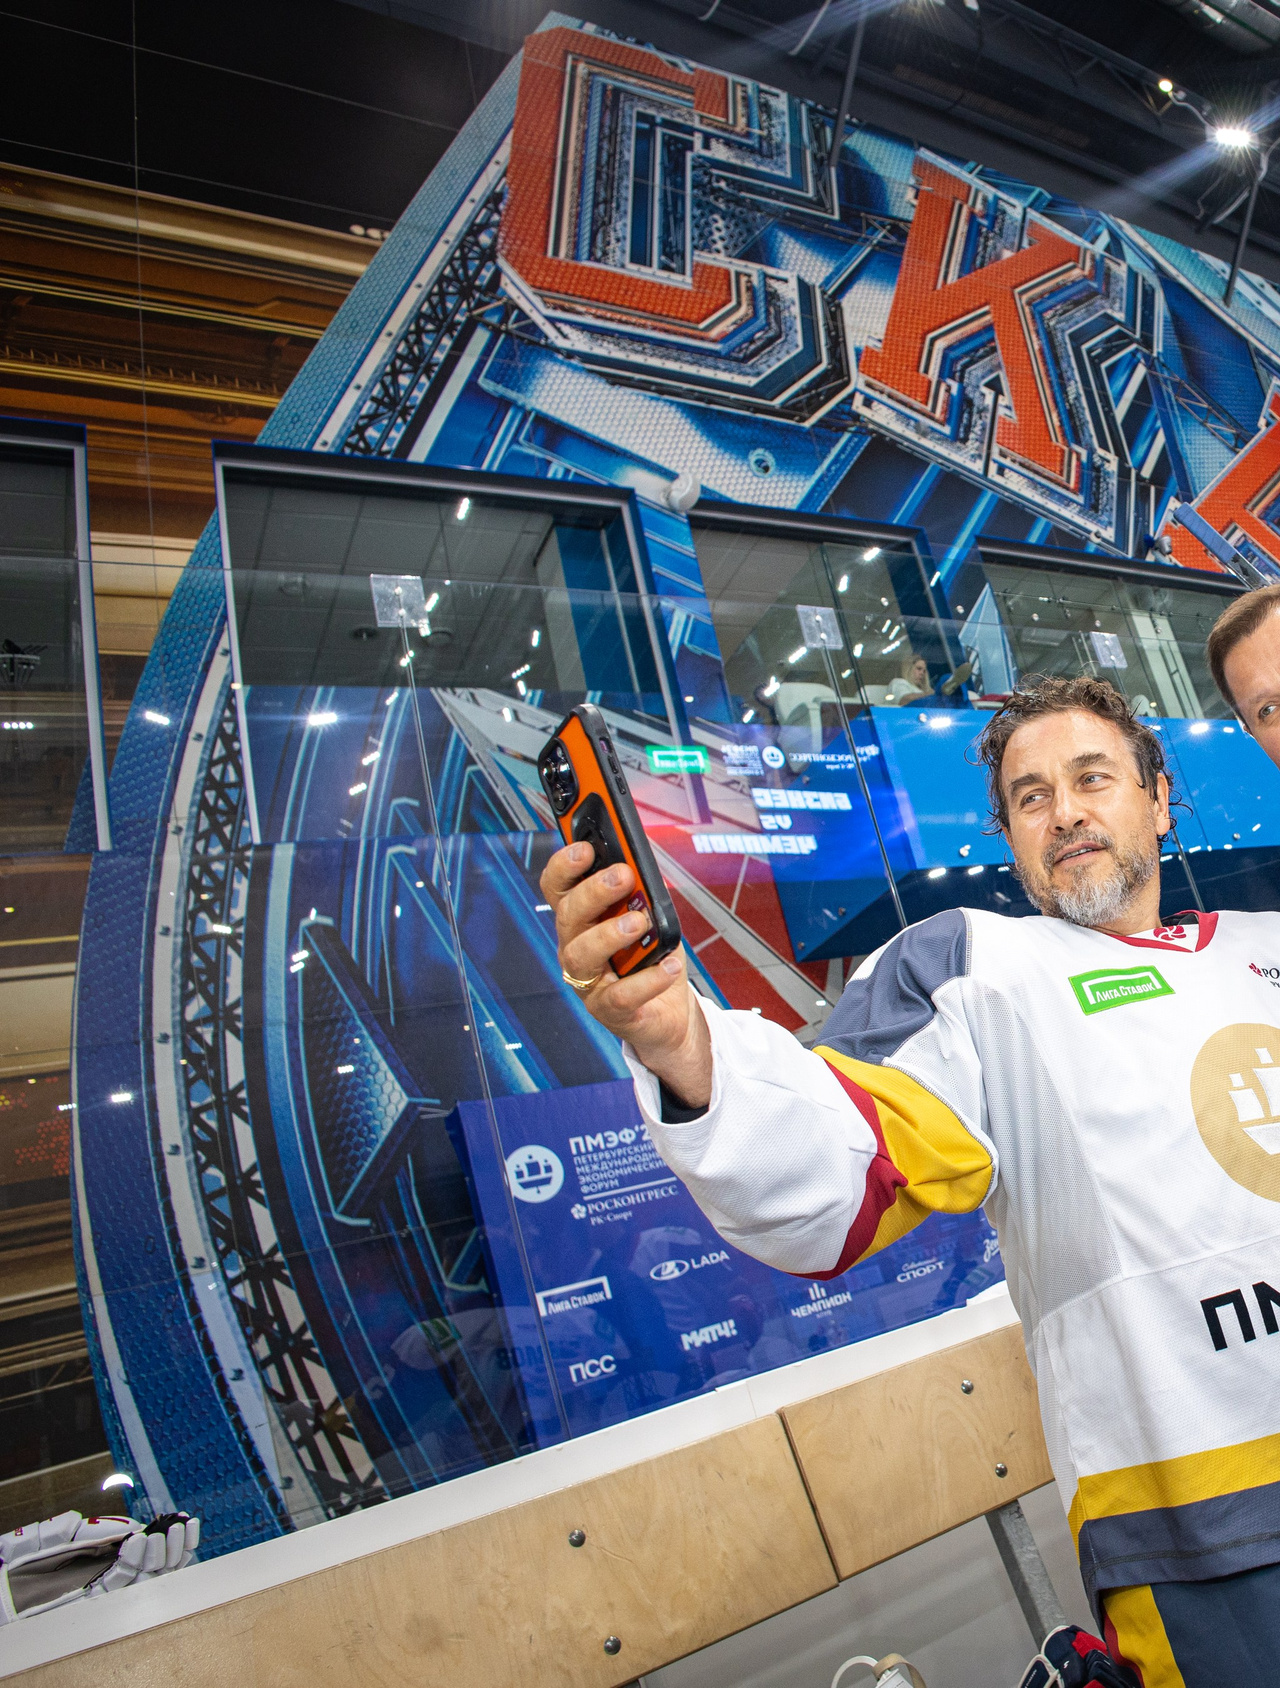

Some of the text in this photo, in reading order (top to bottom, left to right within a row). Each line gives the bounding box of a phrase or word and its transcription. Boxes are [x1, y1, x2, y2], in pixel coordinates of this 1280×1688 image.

[580, 1178, 620, 1194] ФОРУМ
[587, 1184, 679, 1215] РОСКОНГРЕСС
[690, 1249, 730, 1270] LADA
[896, 1260, 945, 1283] СПОРТ
[791, 1291, 852, 1318] ЧЕМПИОН
[681, 1318, 738, 1351] МАТЧ!
[568, 1354, 617, 1383] ПСС
